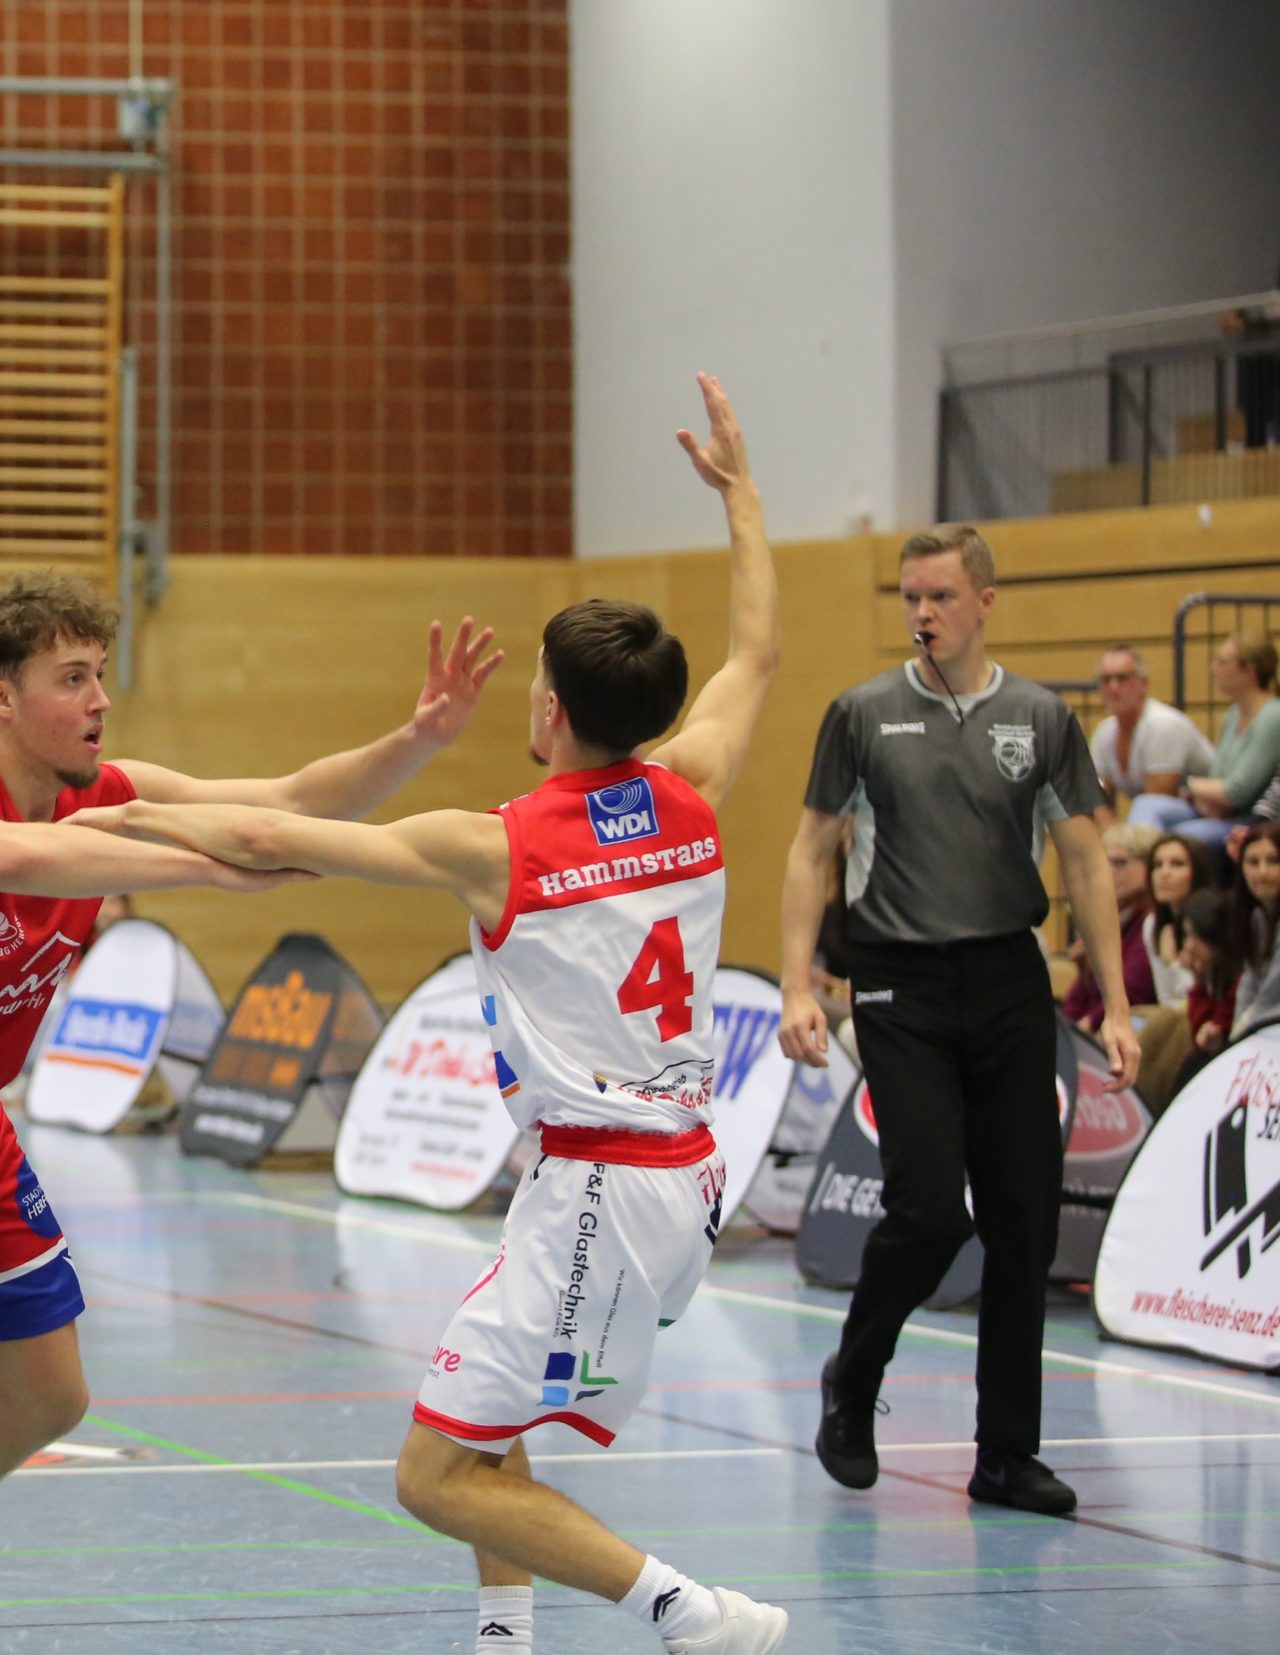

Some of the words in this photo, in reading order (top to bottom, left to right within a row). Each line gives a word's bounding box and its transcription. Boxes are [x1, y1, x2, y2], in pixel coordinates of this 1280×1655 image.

[597, 810, 651, 839] WDI
[617, 916, 693, 1043] 4
[585, 1162, 605, 1205] F&F
[557, 1212, 597, 1341] Glastechnik
